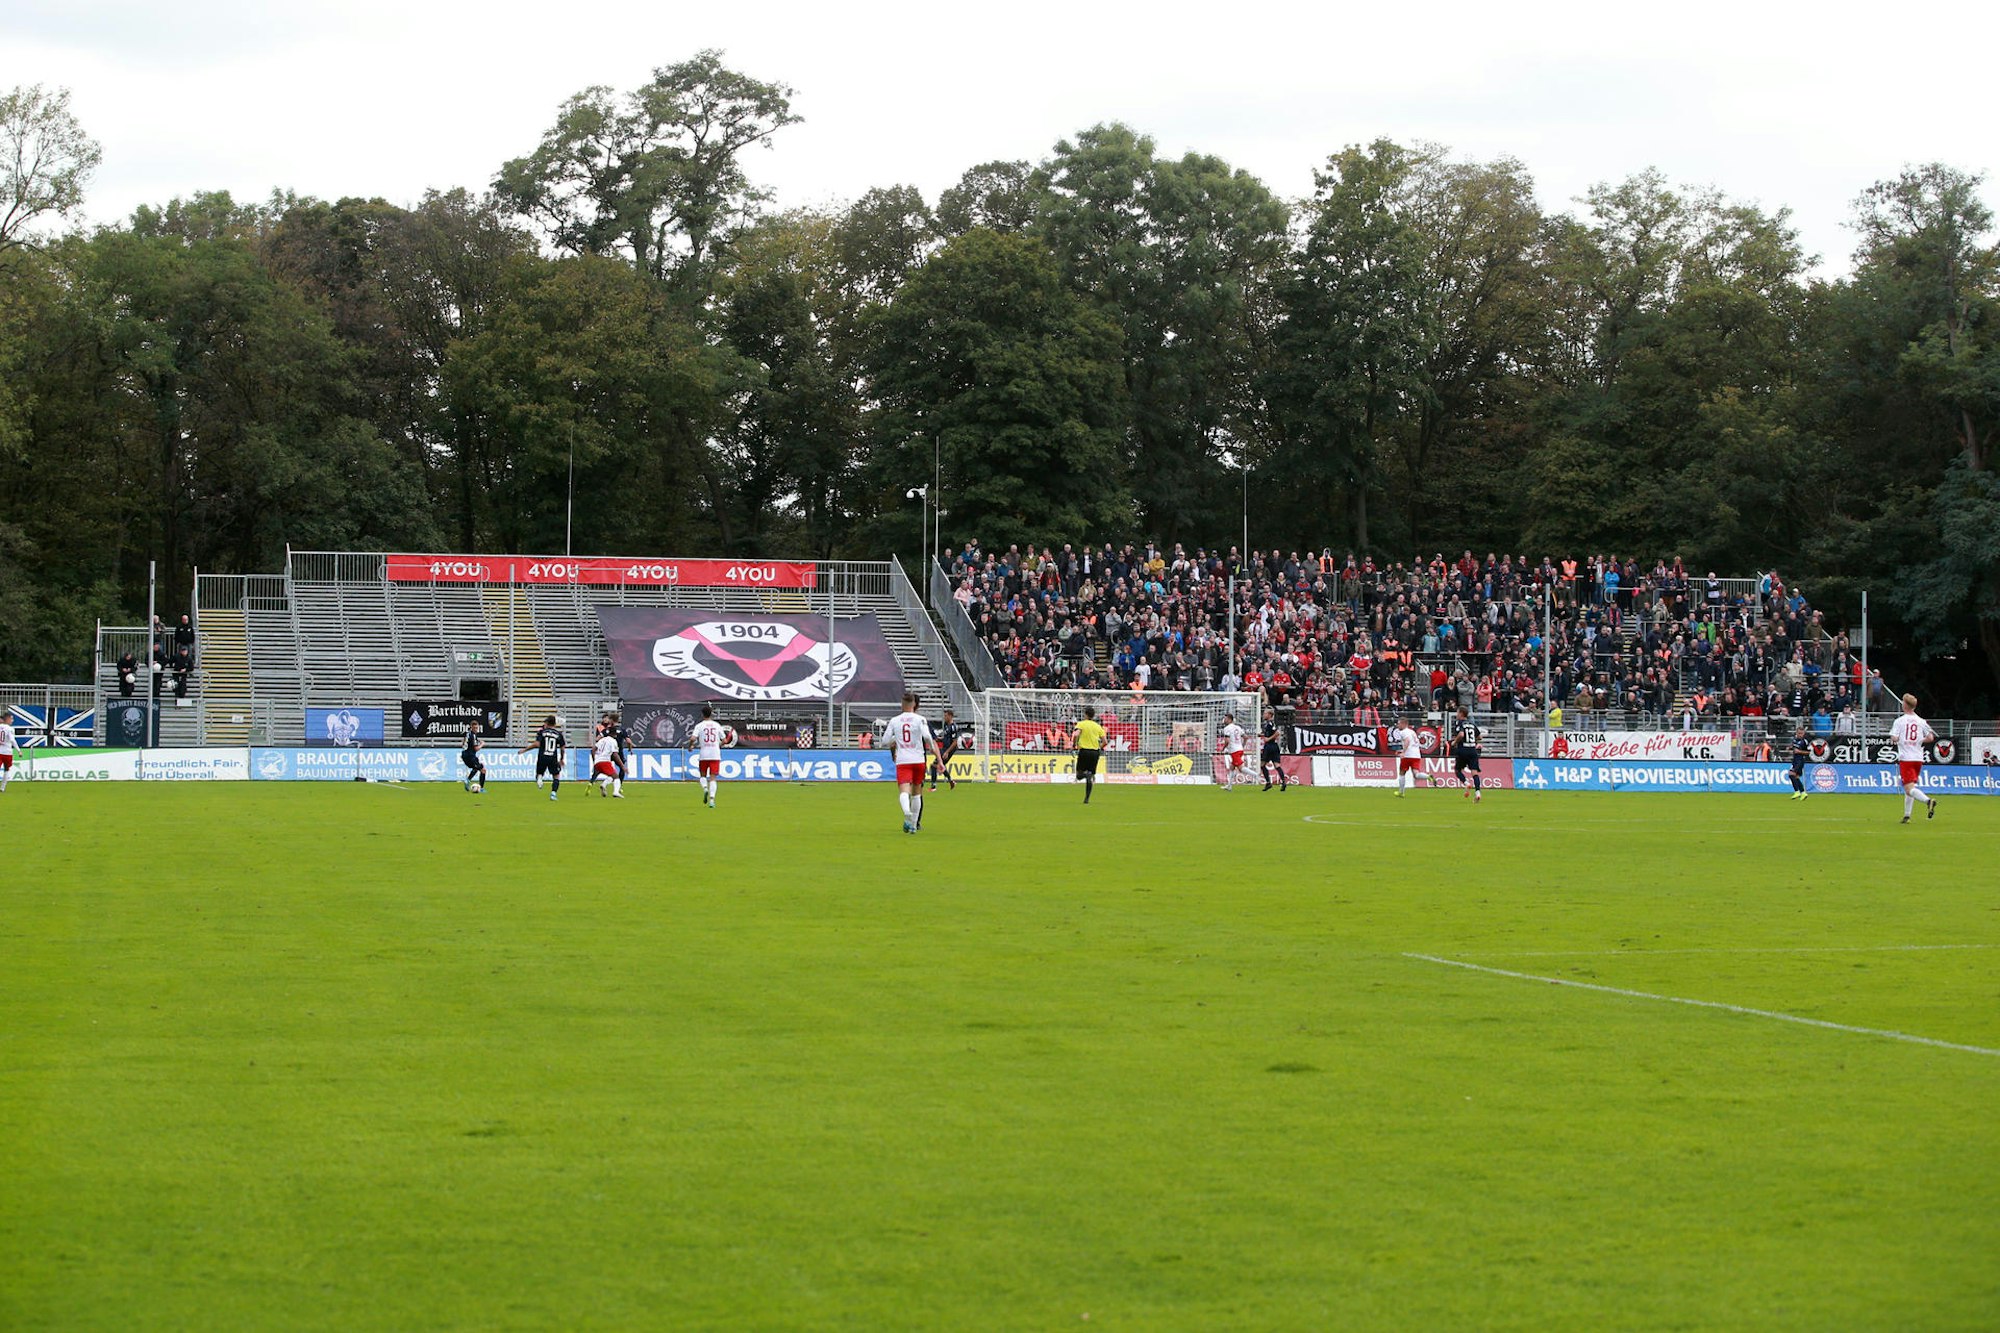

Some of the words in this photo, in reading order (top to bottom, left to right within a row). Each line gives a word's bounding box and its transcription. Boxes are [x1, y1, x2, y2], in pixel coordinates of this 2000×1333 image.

[430, 562, 481, 577] 4YOU
[529, 563, 579, 578] 4YOU
[627, 565, 679, 580] 4YOU
[725, 566, 775, 581] 4YOU
[715, 624, 780, 639] 1904
[659, 651, 801, 699] VIKTORIA
[428, 705, 483, 718] Barrikade
[426, 722, 484, 734] Mannhem
[703, 728, 716, 743] 35
[902, 723, 911, 742] 6
[1465, 728, 1476, 743] 13
[1906, 724, 1918, 741] 18
[545, 737, 556, 752] 10
[1295, 726, 1377, 754] JUNIORS
[1554, 733, 1606, 743] KTORIA
[1591, 742, 1640, 759] Liebe
[1644, 734, 1672, 756] für
[1677, 731, 1726, 748] immer
[135, 759, 211, 768] Freundlich.
[214, 759, 243, 768] Fair.
[297, 752, 409, 766] BRAUCKMANN
[1357, 761, 1383, 769] MBS
[1426, 757, 1472, 773] MB
[12, 770, 110, 780] AUTOGLAS
[135, 769, 164, 779] Und
[167, 768, 217, 779] Überall.
[297, 767, 409, 779] BAUUNTERNEHMEN
[1554, 766, 1593, 783] H&P
[1598, 768, 1793, 786] RENOVIERUNGSSERVIC
[1844, 774, 1878, 788] Trink
[1953, 775, 1980, 788] Fühl
[1983, 777, 2000, 788] dic
